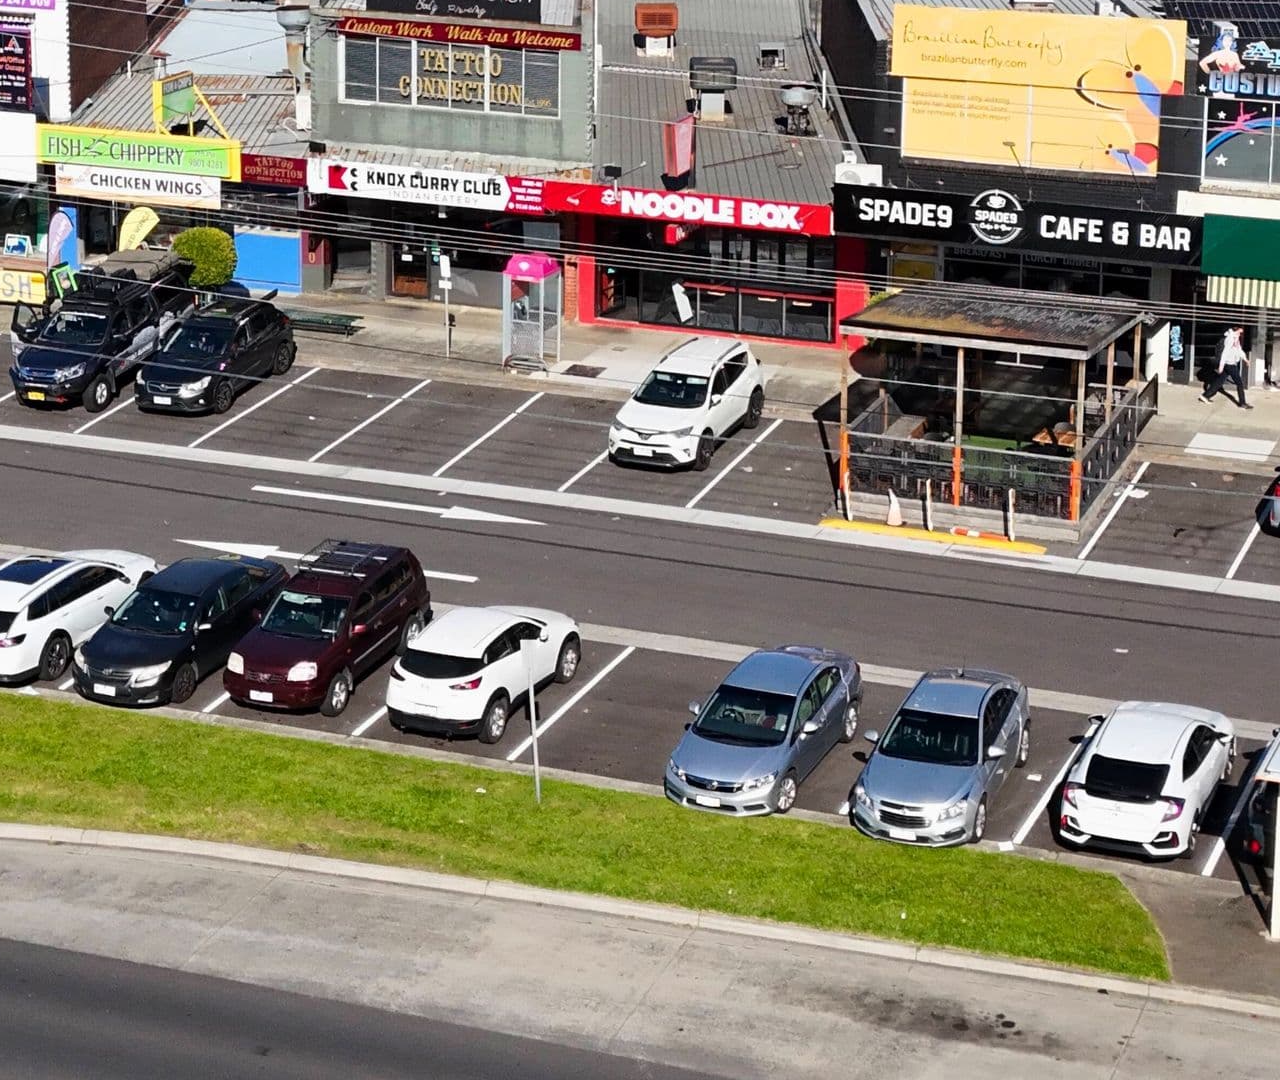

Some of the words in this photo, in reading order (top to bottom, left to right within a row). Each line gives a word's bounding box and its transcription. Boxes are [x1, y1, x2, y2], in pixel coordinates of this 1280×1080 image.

[344, 18, 393, 35] Custom
[395, 21, 434, 39] Work
[445, 25, 509, 45] Walk-ins
[512, 29, 575, 49] Welcome
[902, 19, 980, 46] Brazilian
[983, 24, 1063, 66] Butterfly
[420, 48, 503, 78] TATTOO
[920, 52, 1028, 69] brazilianbutterfly.com
[47, 137, 81, 157] FISH
[109, 143, 184, 166] CHIPPERY
[254, 155, 295, 170] TATTOO
[90, 173, 158, 191] CHICKEN
[160, 178, 203, 195] WINGS
[244, 165, 304, 180] CONNECTION
[366, 170, 407, 189] KNOX
[409, 174, 460, 193] CURRY
[463, 179, 502, 196] CLUB
[388, 189, 431, 203] INDIAN
[434, 193, 480, 206] EATERY
[620, 190, 735, 224] NOODLE
[741, 201, 801, 231] BOX
[858, 197, 953, 229] SPADE9
[974, 209, 1018, 225] SPADE9
[1039, 214, 1104, 244] CAFE
[1111, 221, 1130, 246] &
[1139, 223, 1191, 252] BAR
